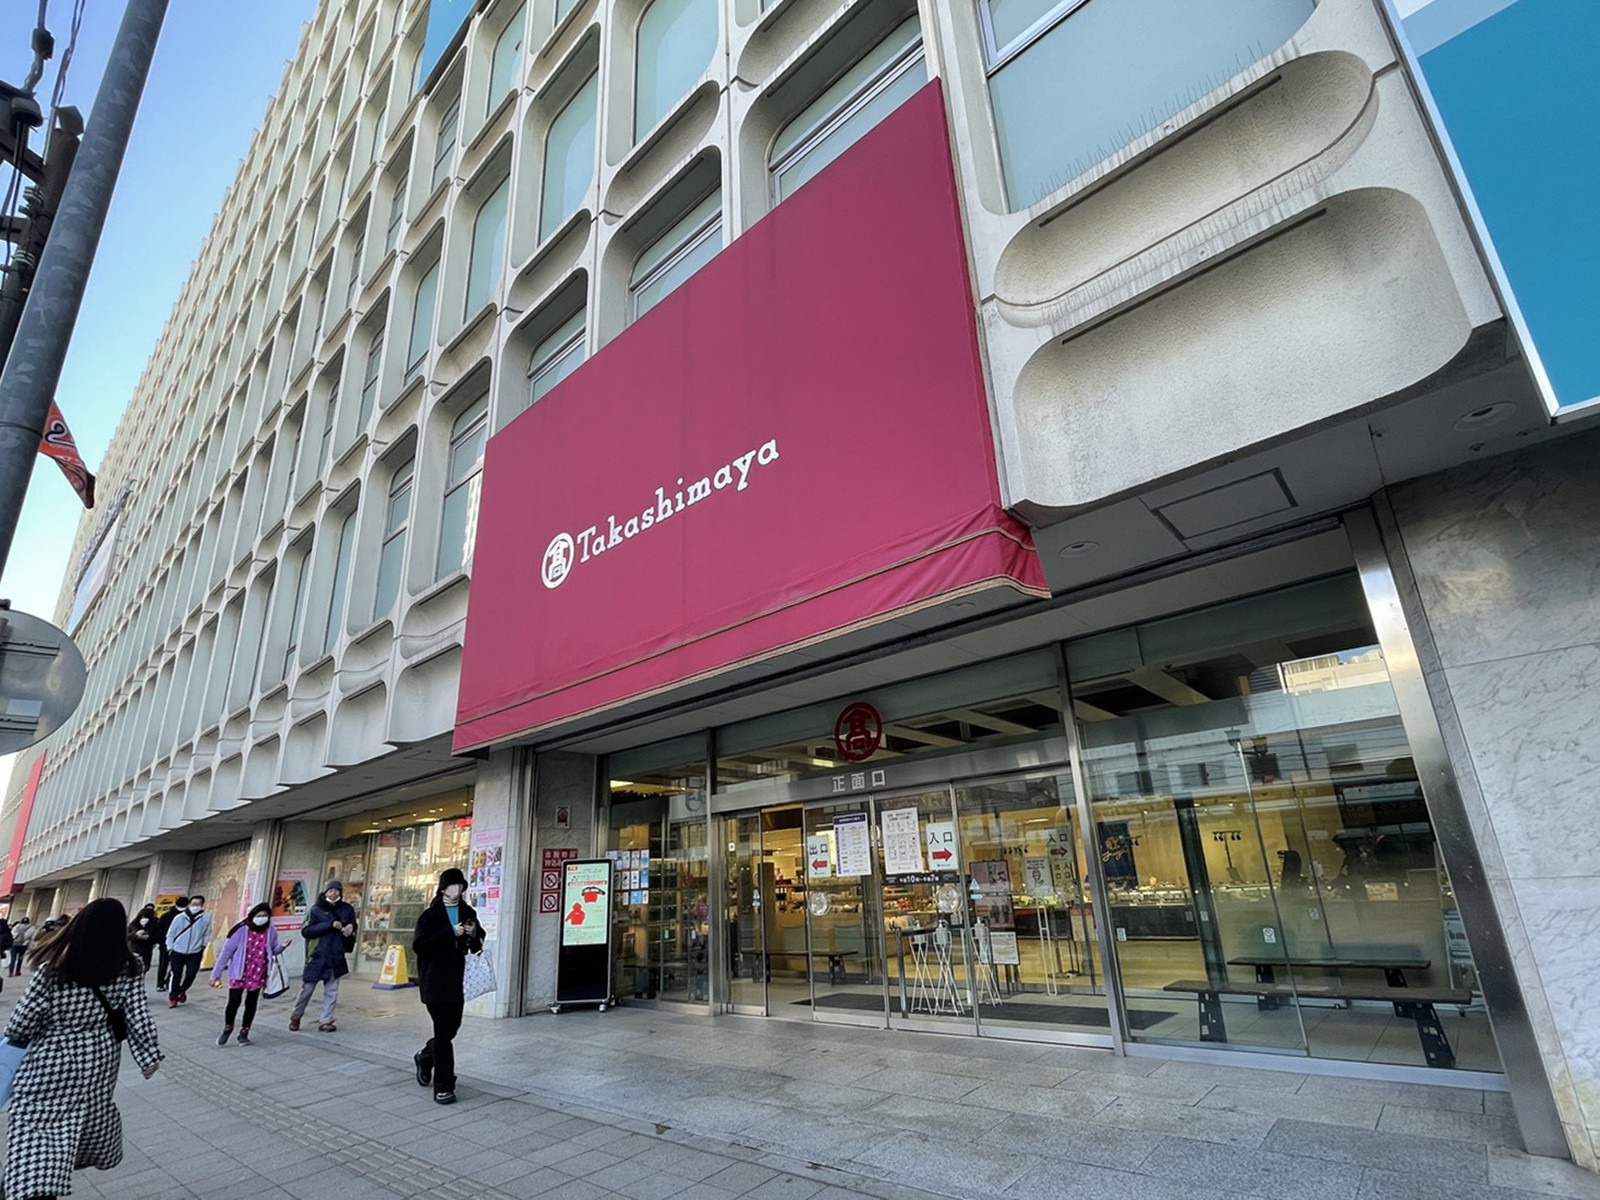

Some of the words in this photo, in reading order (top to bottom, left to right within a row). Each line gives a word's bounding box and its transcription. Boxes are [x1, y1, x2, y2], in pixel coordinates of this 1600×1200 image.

[576, 438, 780, 563] Takashimaya
[832, 770, 885, 792] 正面口
[928, 831, 953, 845] 入口
[809, 843, 828, 855] 出口
